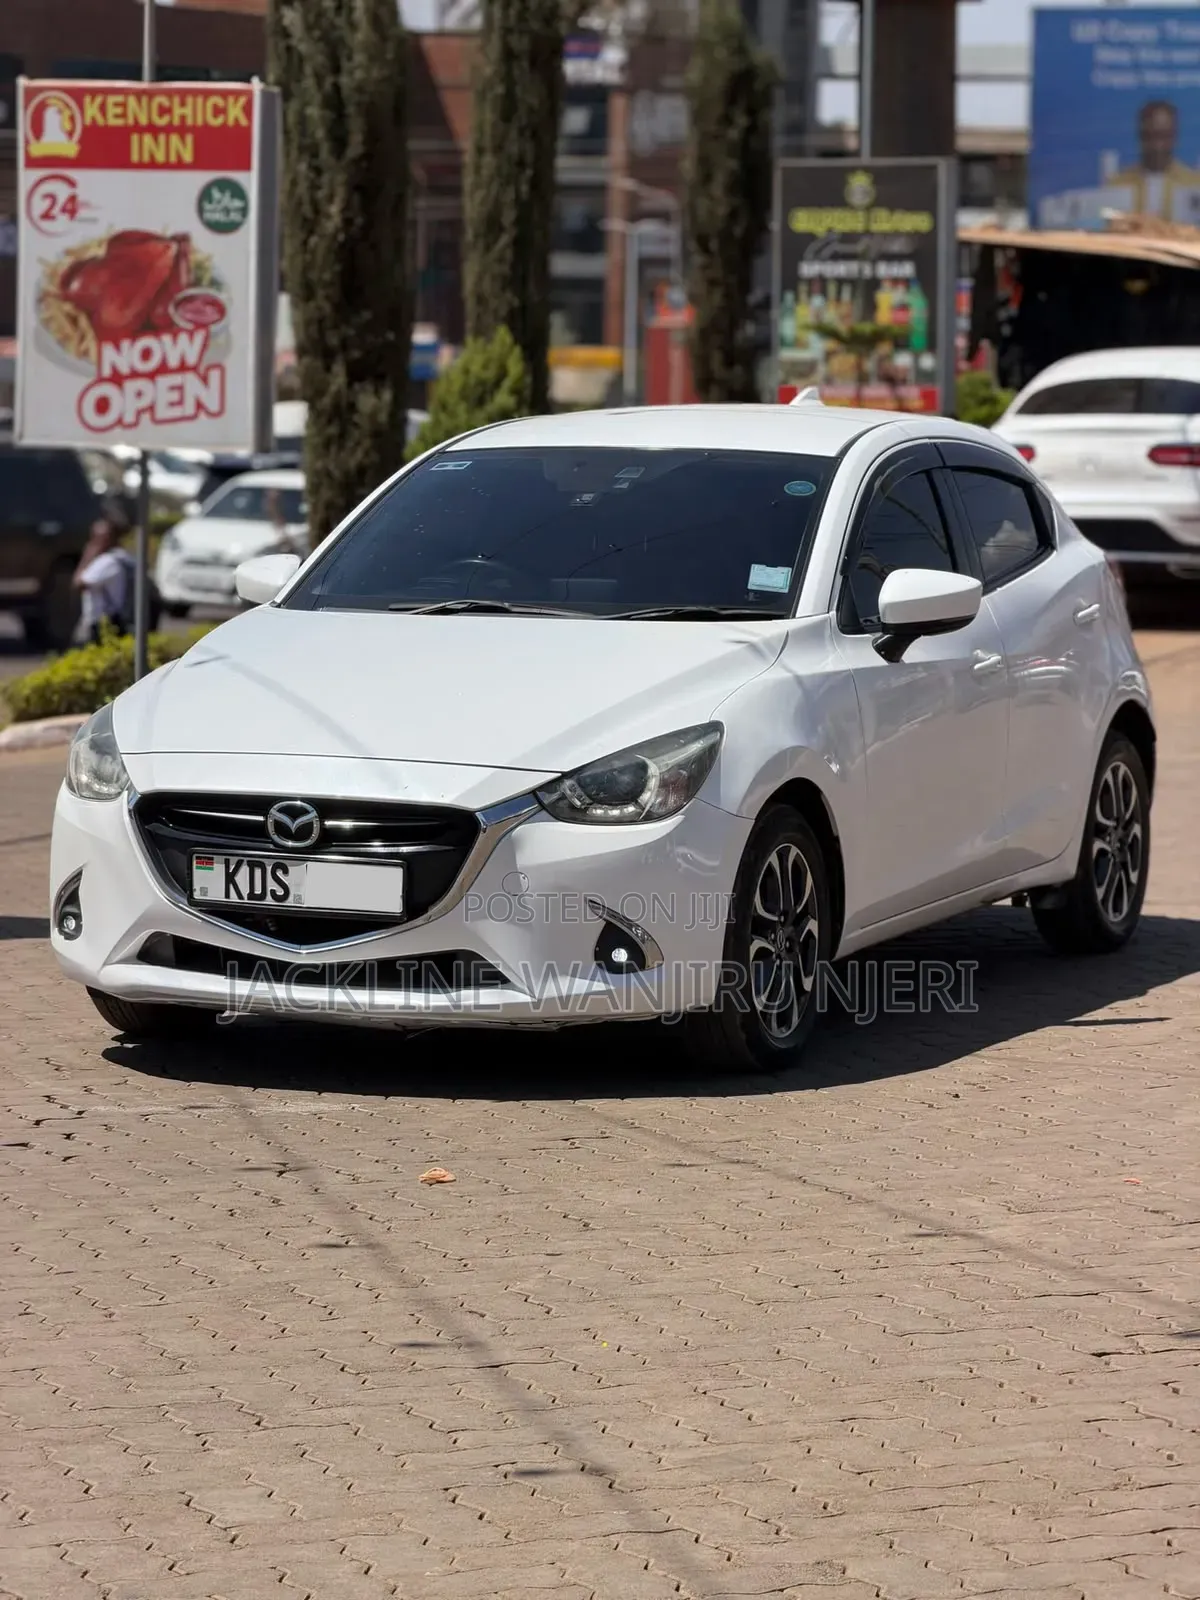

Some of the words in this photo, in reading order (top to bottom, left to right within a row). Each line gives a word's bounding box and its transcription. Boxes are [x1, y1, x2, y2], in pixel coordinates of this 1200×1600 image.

[84, 94, 249, 127] KENCHICK
[130, 133, 194, 164] INN
[40, 192, 78, 220] 24
[101, 328, 207, 377] NOW
[79, 366, 223, 431] OPEN
[224, 857, 290, 903] KDS
